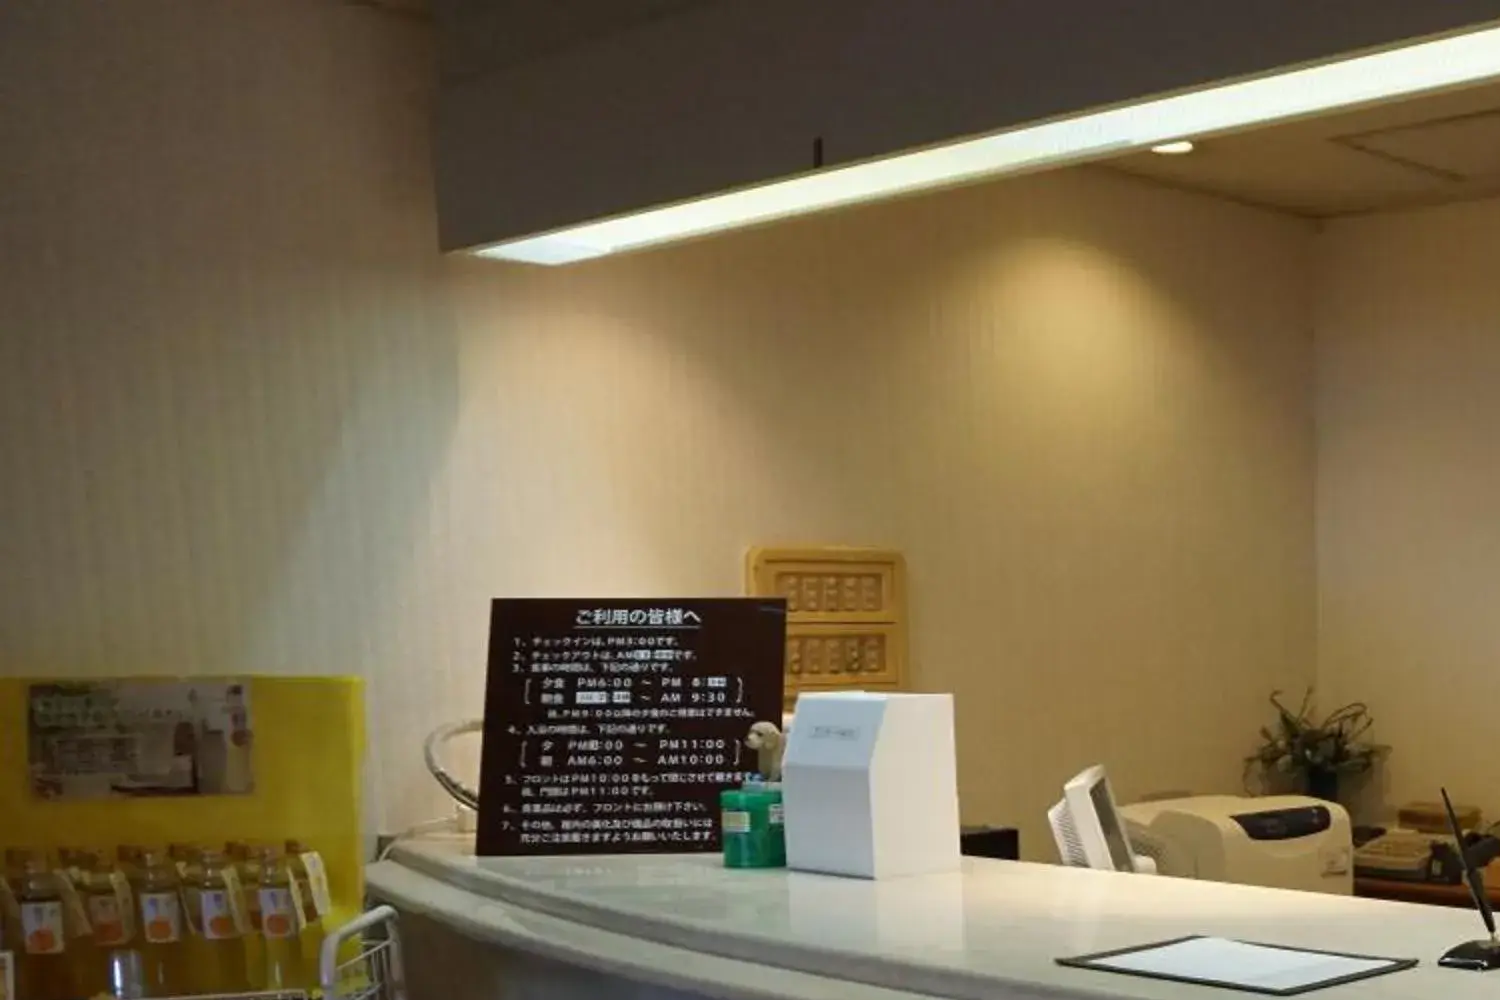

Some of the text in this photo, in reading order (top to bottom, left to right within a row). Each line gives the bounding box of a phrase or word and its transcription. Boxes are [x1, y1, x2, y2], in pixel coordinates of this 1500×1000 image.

[576, 608, 701, 625] ご利用の皆様へ
[659, 739, 725, 749] PM11:00
[657, 754, 725, 765] AM10:00
